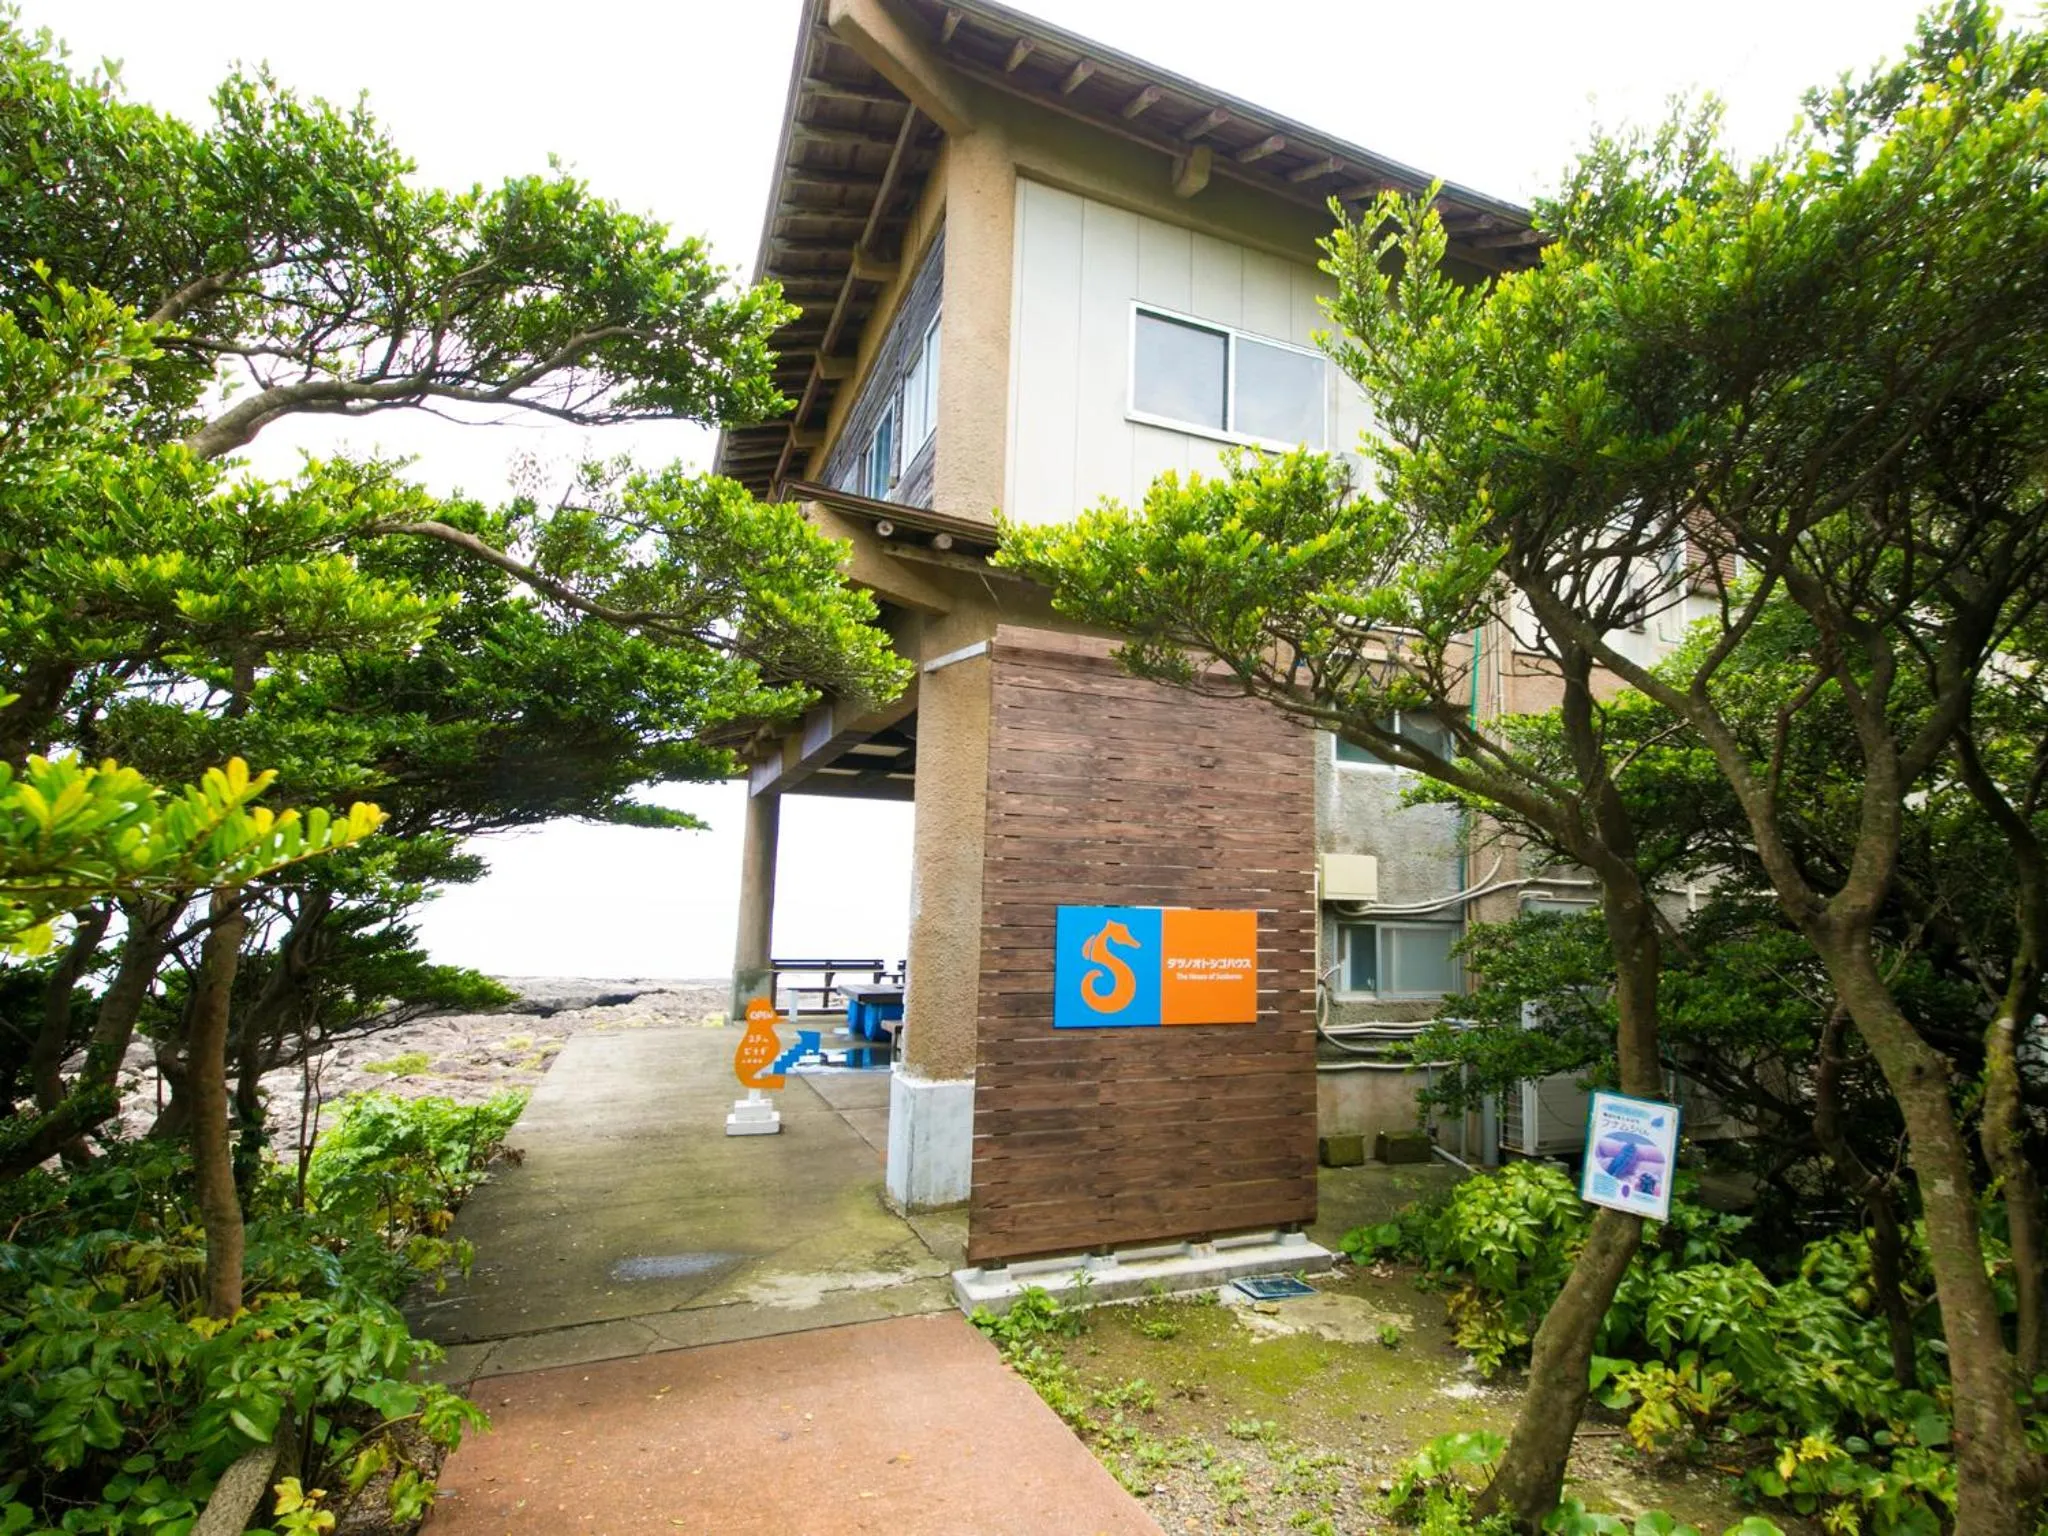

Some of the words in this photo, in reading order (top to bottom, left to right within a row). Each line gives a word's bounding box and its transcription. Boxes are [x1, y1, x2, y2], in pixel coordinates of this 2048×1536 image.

[1167, 958, 1252, 969] タツノオトシゴハウス
[750, 1011, 773, 1020] OPEN
